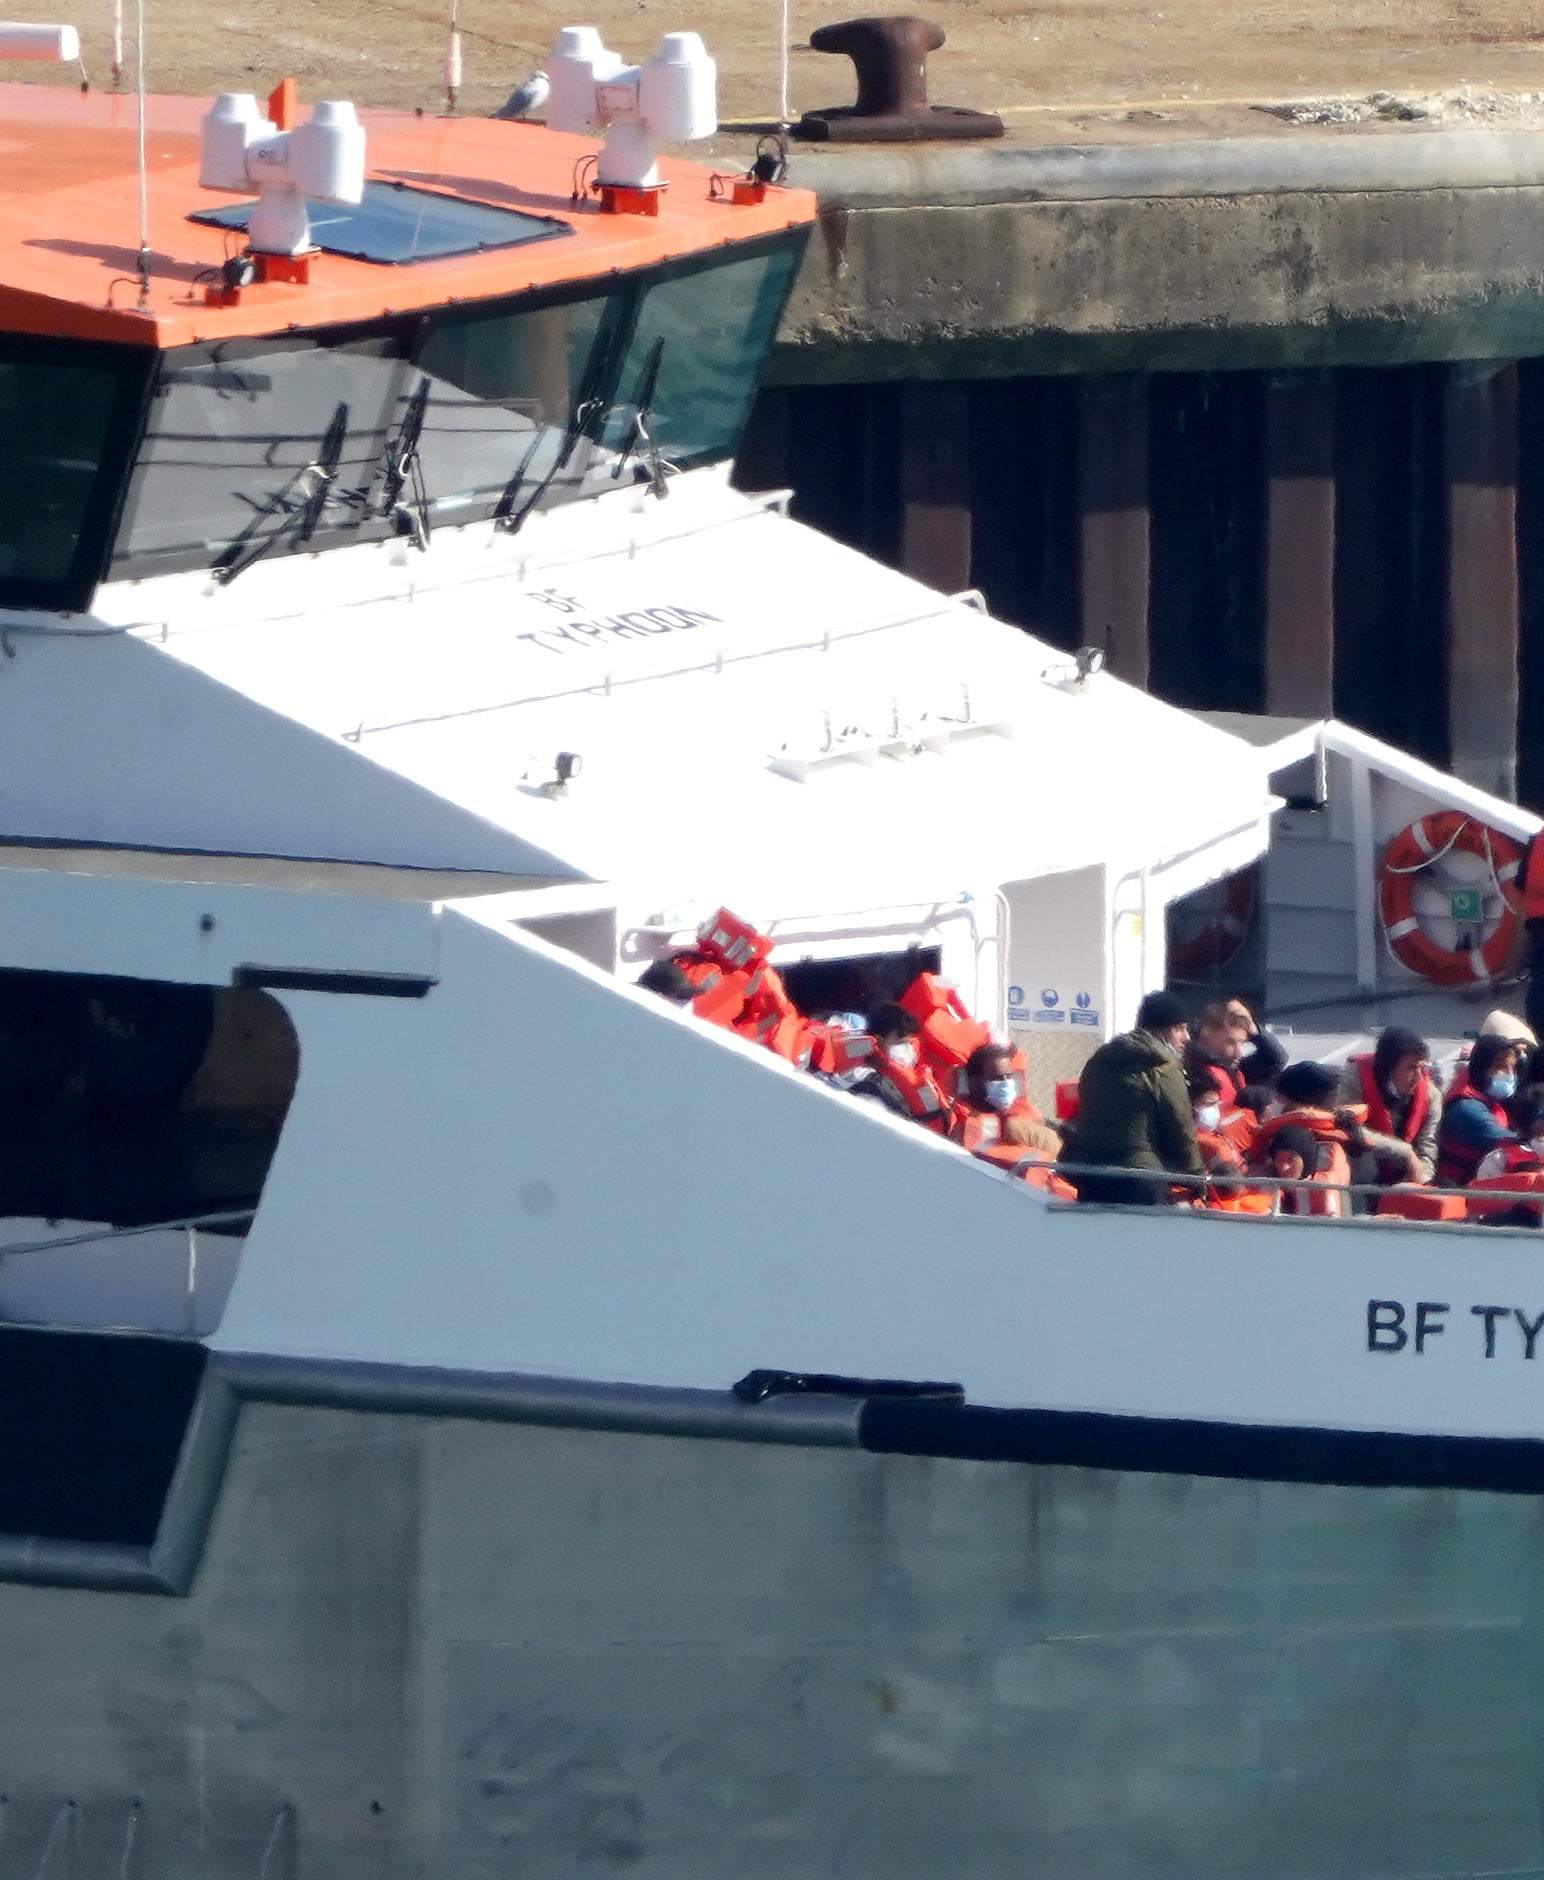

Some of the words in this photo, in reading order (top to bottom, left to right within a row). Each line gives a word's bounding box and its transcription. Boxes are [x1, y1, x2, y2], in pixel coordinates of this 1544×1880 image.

[524, 588, 586, 614] BF
[515, 604, 724, 655] TYPHOON
[1366, 1299, 1451, 1355] BF
